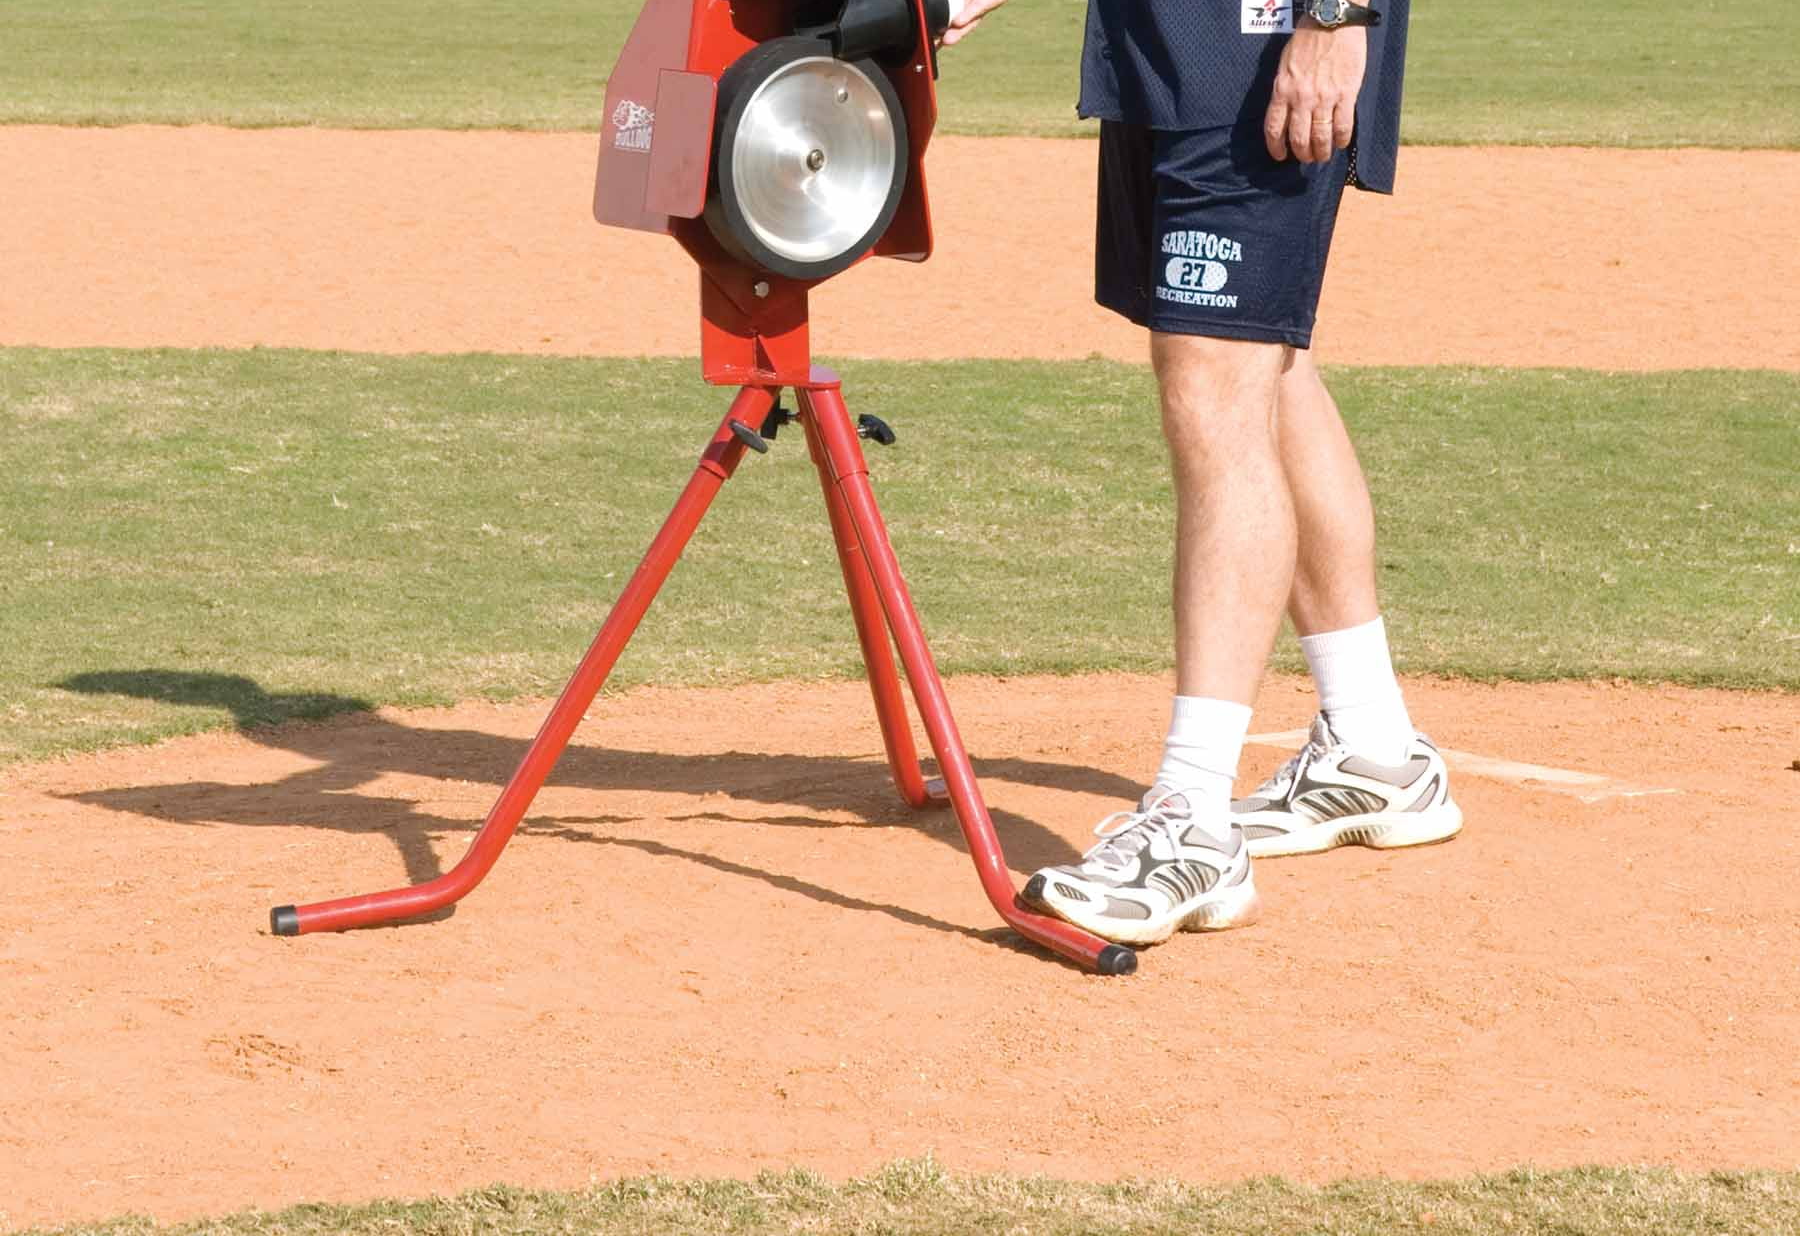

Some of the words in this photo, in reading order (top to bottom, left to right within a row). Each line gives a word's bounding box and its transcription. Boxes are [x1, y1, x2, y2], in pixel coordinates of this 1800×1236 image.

[1161, 230, 1242, 262] SARATOGA
[1180, 262, 1206, 287] 27
[1156, 286, 1239, 308] RECREATION
